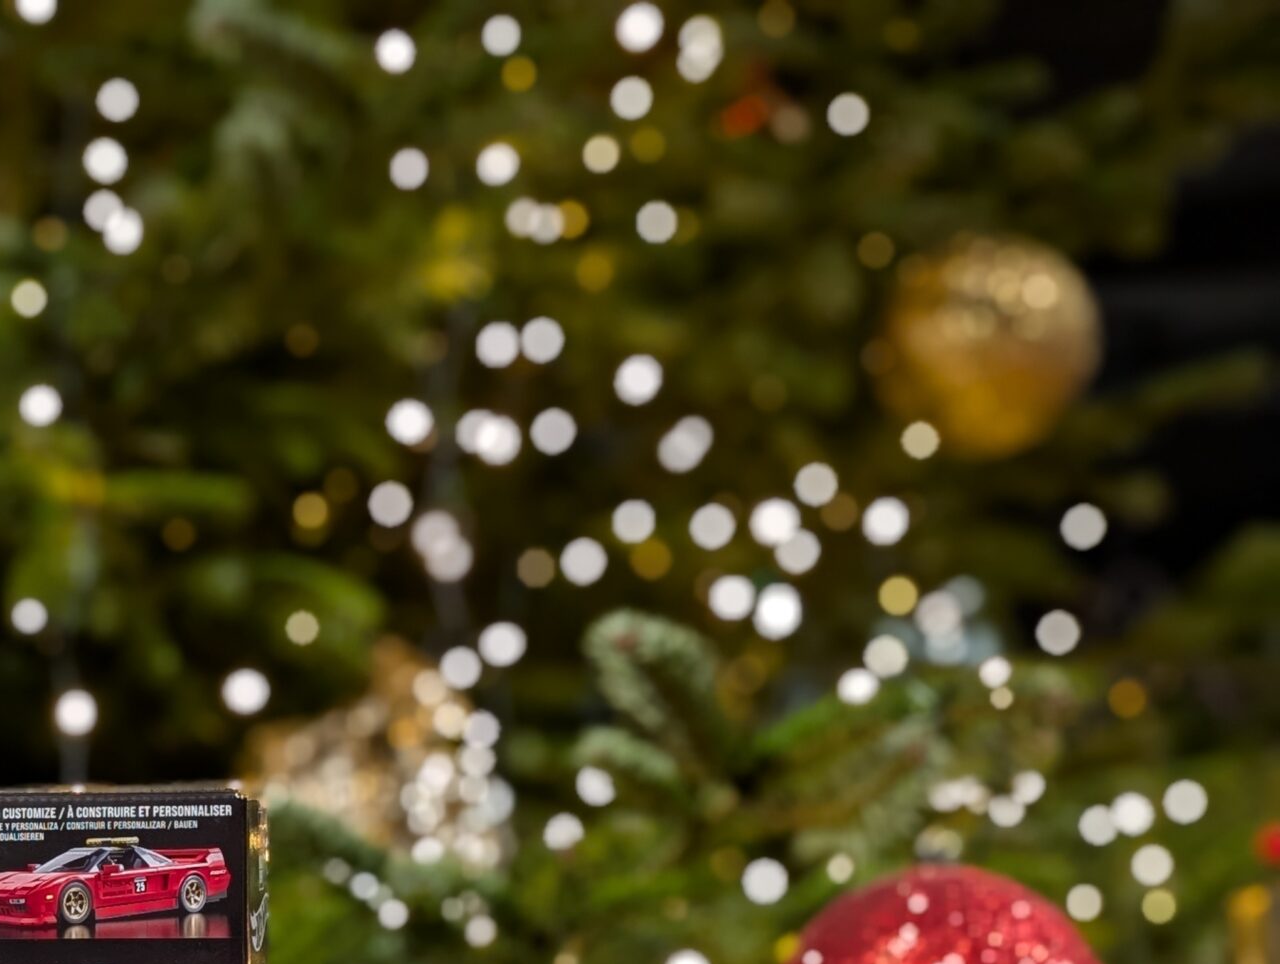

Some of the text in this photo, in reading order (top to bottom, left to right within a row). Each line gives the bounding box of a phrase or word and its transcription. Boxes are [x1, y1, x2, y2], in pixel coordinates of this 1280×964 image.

[2, 807, 57, 819] CUSTOMIZE
[67, 804, 74, 818] À
[76, 806, 136, 818] CONSTRUIRE
[138, 806, 151, 817] ET
[153, 805, 232, 817] PERSONNALISER
[5, 822, 10, 831] Y
[11, 822, 58, 831] PERSONALIZA
[66, 821, 106, 830] CONSTRUIR
[107, 821, 112, 830] E
[113, 820, 166, 830] PERSONALIZAR
[174, 820, 198, 829] BAUEN
